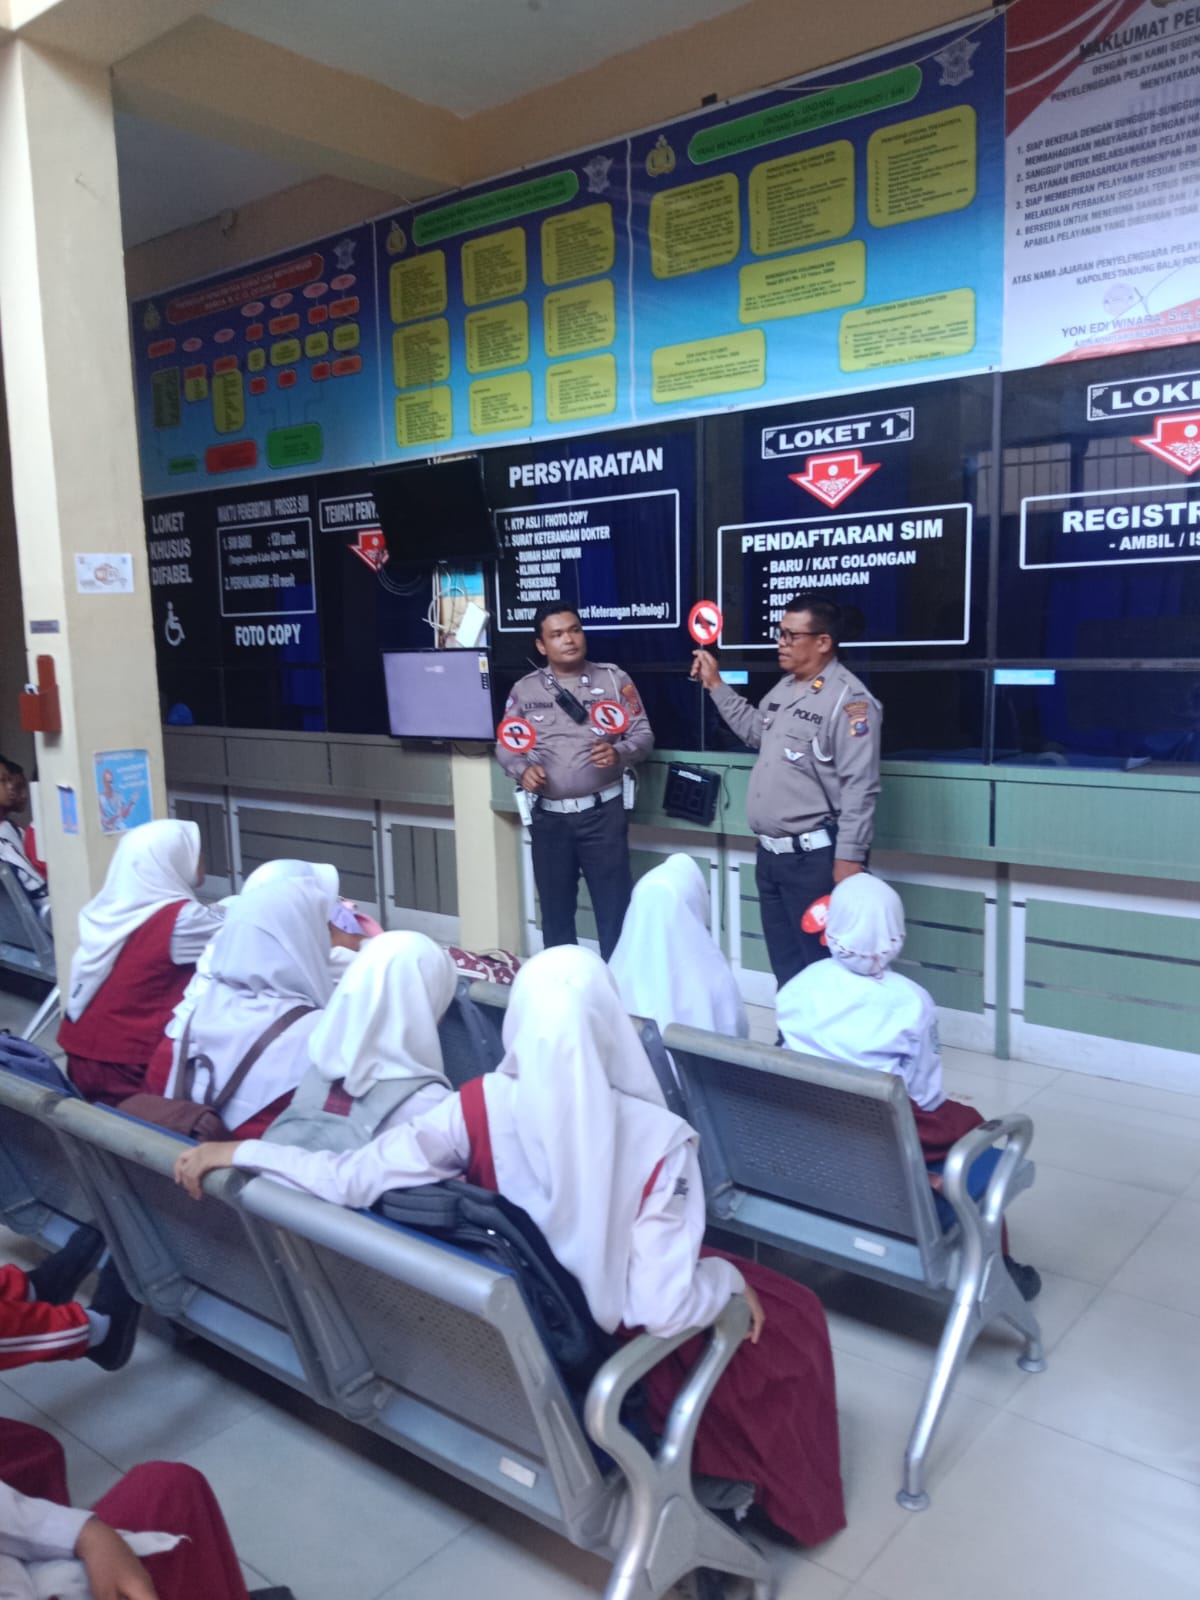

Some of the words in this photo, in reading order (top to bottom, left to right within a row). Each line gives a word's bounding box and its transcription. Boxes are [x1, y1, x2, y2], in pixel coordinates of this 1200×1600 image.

[1079, 16, 1169, 58] MAKLUMAT
[1012, 275, 1032, 286] ATAS
[1033, 269, 1056, 282] NAMA
[1058, 261, 1094, 276] JAJARAN
[1062, 324, 1086, 338] YON
[779, 421, 871, 450] LOKET
[881, 418, 895, 436] 1
[509, 447, 663, 488] PERSYARATAN
[152, 512, 185, 534] LOKET
[325, 503, 354, 523] TEMPAT
[511, 517, 525, 531] KTP
[525, 515, 541, 529] ASLI
[568, 511, 589, 526] COPY
[511, 532, 533, 547] SURAT
[534, 528, 581, 545] KETERANGAN
[581, 525, 610, 541] DOKTER
[742, 523, 893, 553] PENDAFTARAN
[900, 518, 943, 541] SIM
[1119, 533, 1175, 551] AMBIL
[150, 538, 192, 560] KHUSUS
[769, 558, 804, 573] BARU
[812, 555, 839, 571] KAT
[841, 550, 916, 569] GOLONGAN
[152, 564, 193, 586] DIFABEL
[519, 576, 557, 589] PUSKESMAS
[769, 571, 870, 590] PERPANJANGAN
[542, 589, 560, 600] POLRI
[590, 605, 630, 620] Keterangan
[631, 603, 664, 618] Psikologi
[234, 625, 265, 647] FOTO
[267, 623, 301, 645] COPY
[792, 708, 823, 725] POLRI
[509, 725, 524, 746] P
